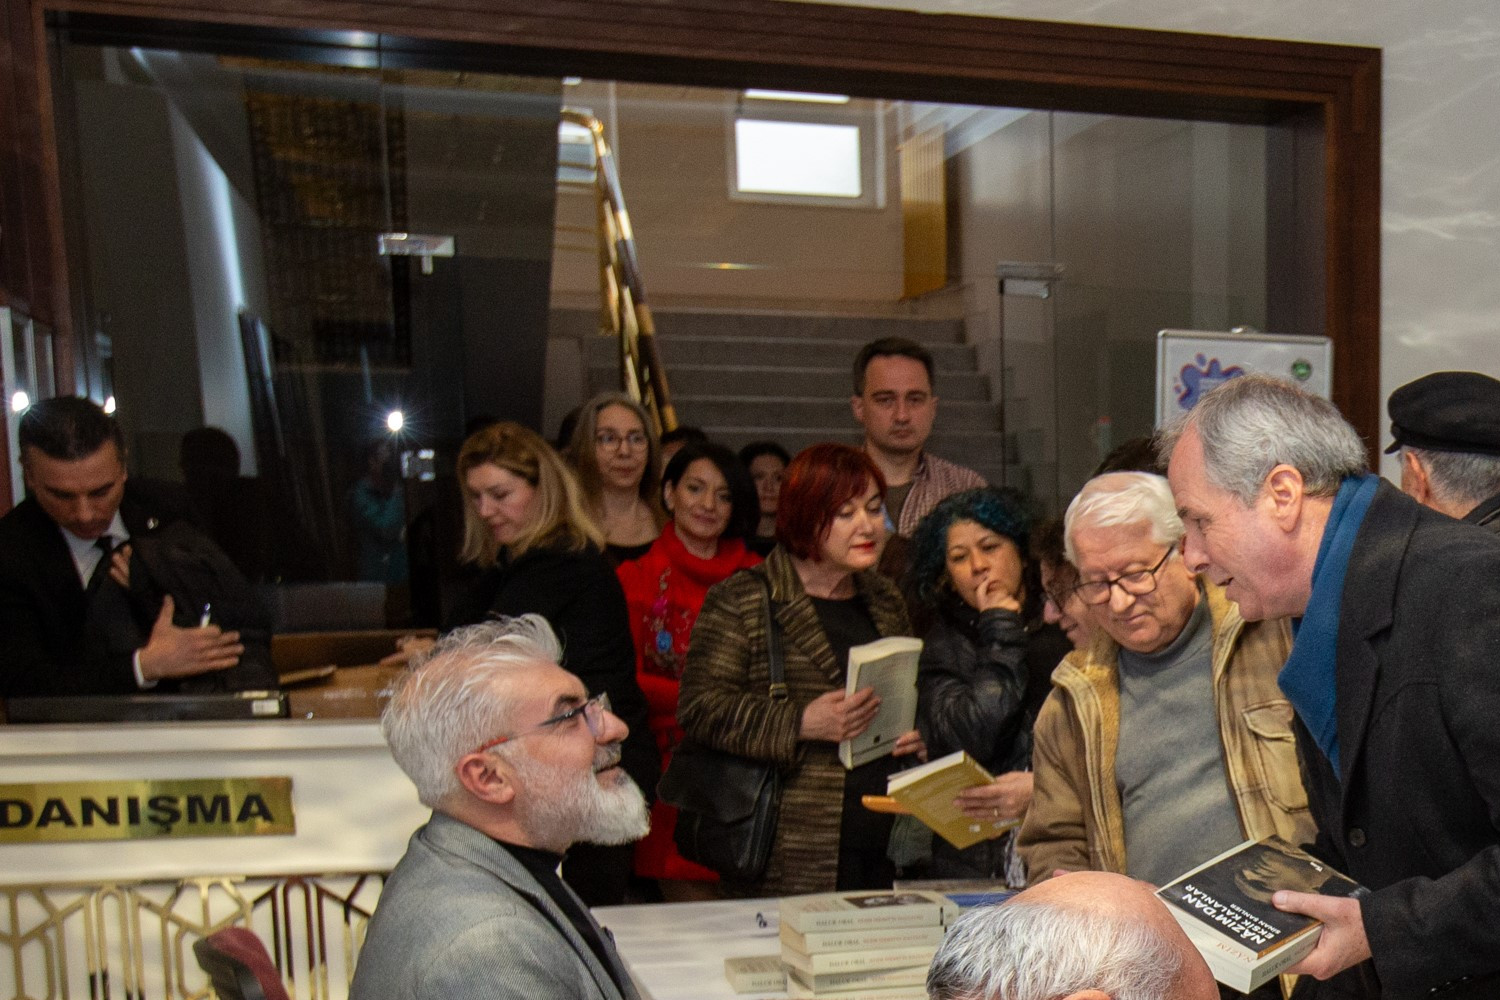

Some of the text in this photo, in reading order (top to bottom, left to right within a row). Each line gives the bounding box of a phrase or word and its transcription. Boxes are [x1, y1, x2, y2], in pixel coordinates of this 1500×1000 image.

[0, 794, 274, 834] DANIŞMA
[1182, 893, 1266, 945] NÂZIM'DAN
[1185, 884, 1275, 940] EKSİK KALANLAR
